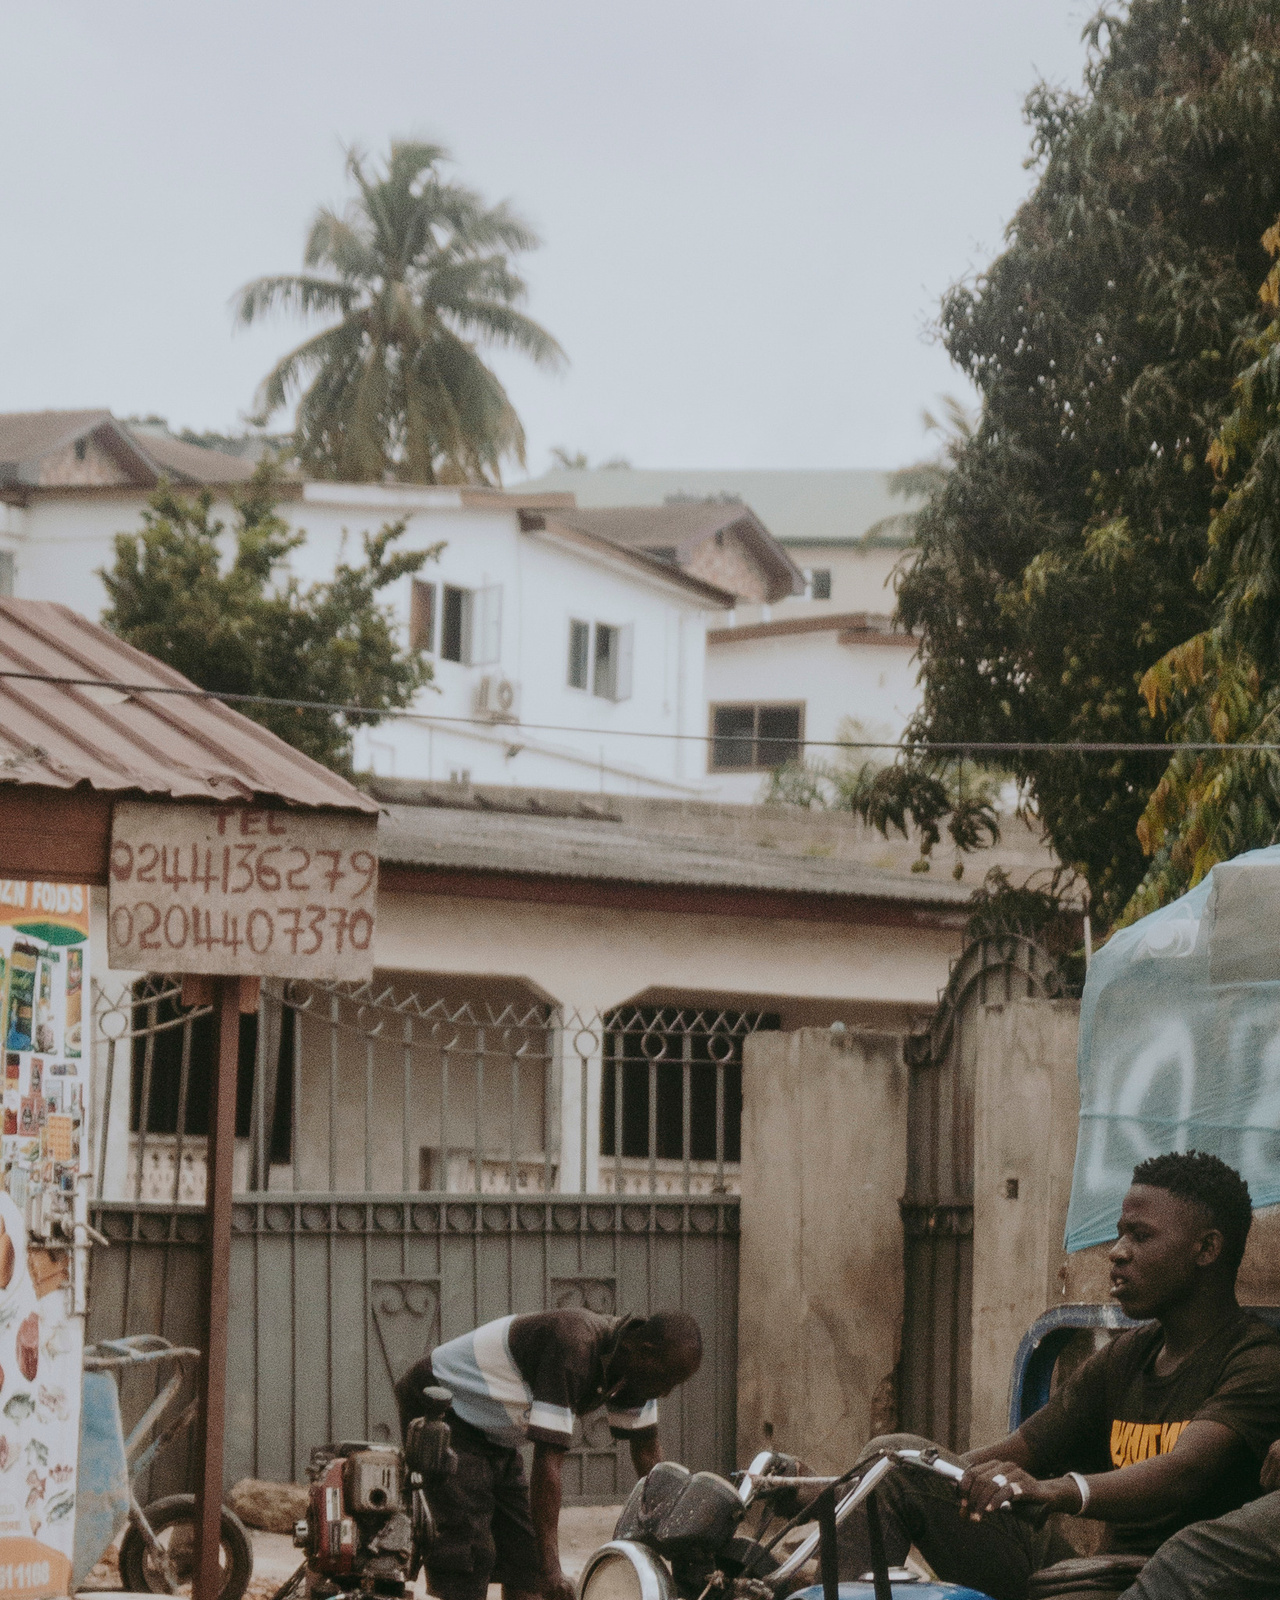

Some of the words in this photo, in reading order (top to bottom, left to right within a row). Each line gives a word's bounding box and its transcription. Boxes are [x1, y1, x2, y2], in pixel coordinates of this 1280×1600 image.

[209, 807, 287, 835] TEL
[110, 841, 377, 900] 0244136279
[110, 901, 374, 957] 0204407370
